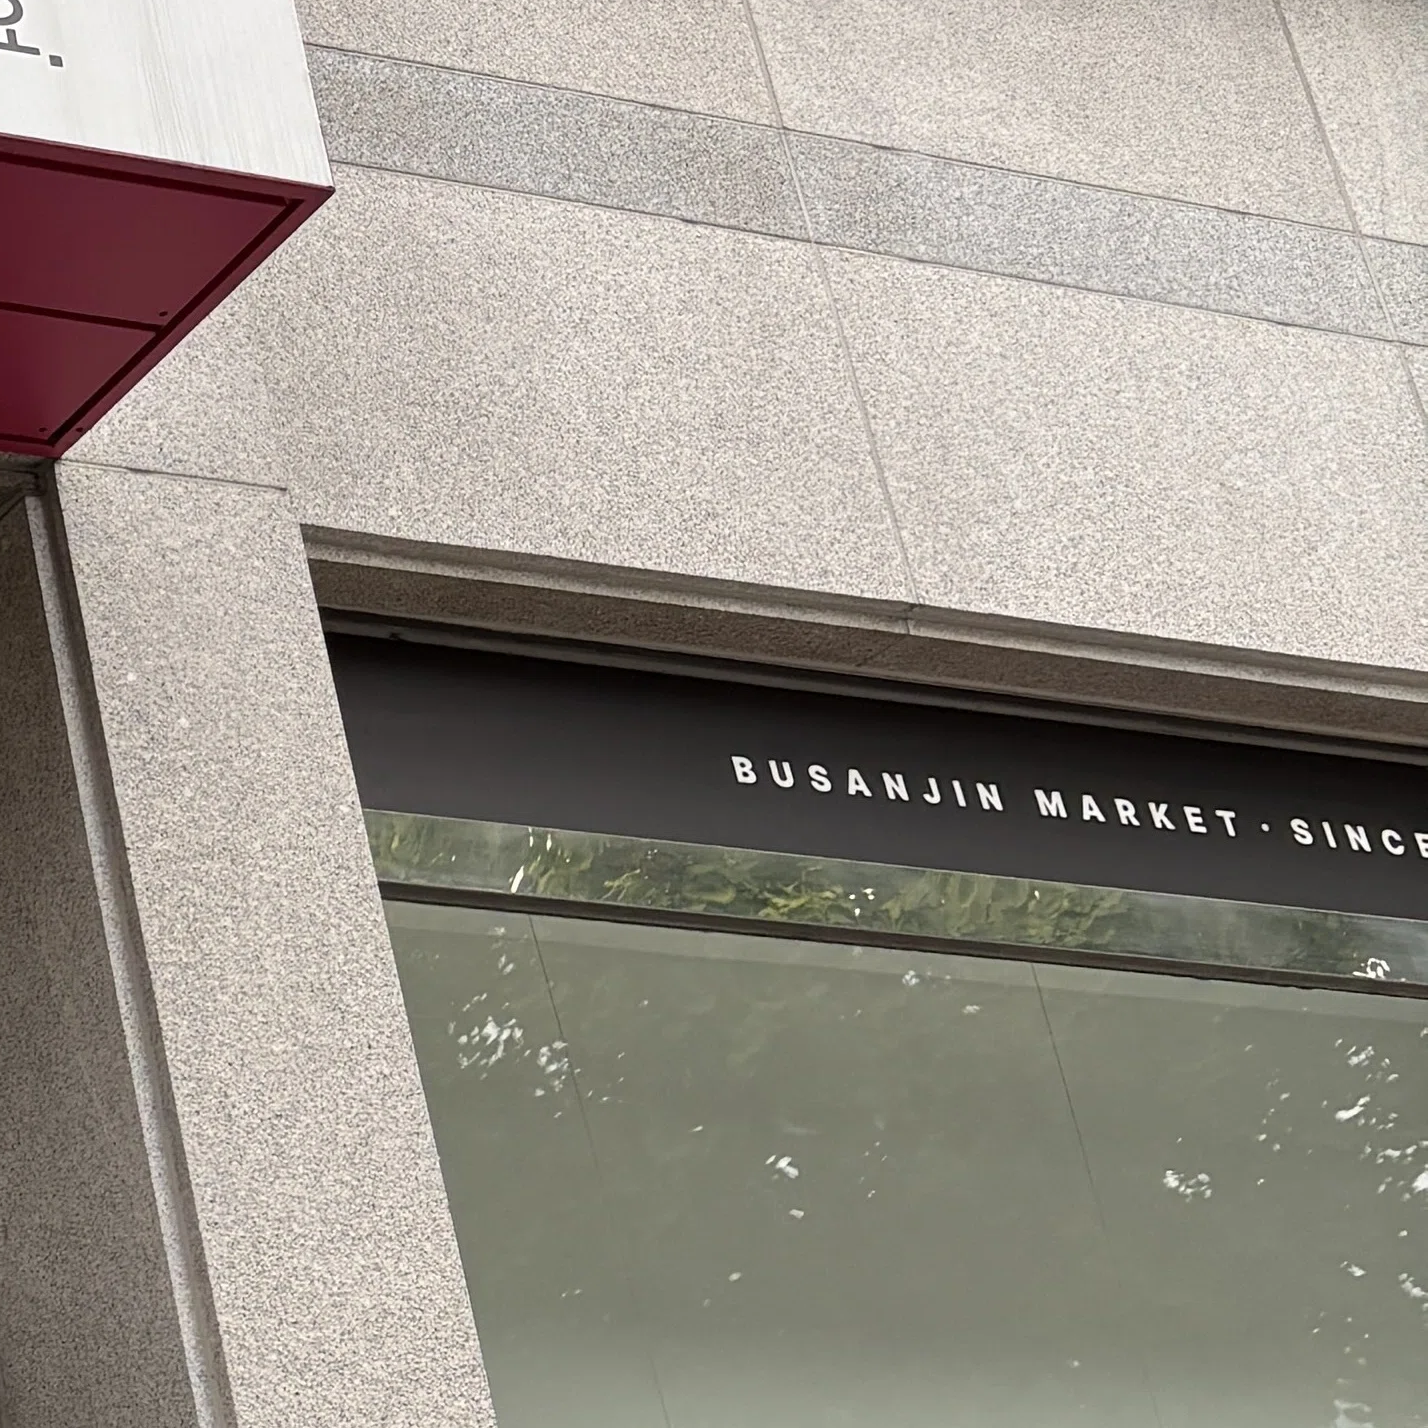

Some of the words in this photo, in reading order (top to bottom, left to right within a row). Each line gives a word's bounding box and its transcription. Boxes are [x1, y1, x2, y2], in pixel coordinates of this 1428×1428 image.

[730, 754, 1004, 812] BUSANJIN
[1034, 787, 1238, 837] MARKET
[1290, 818, 1428, 858] SINCE
